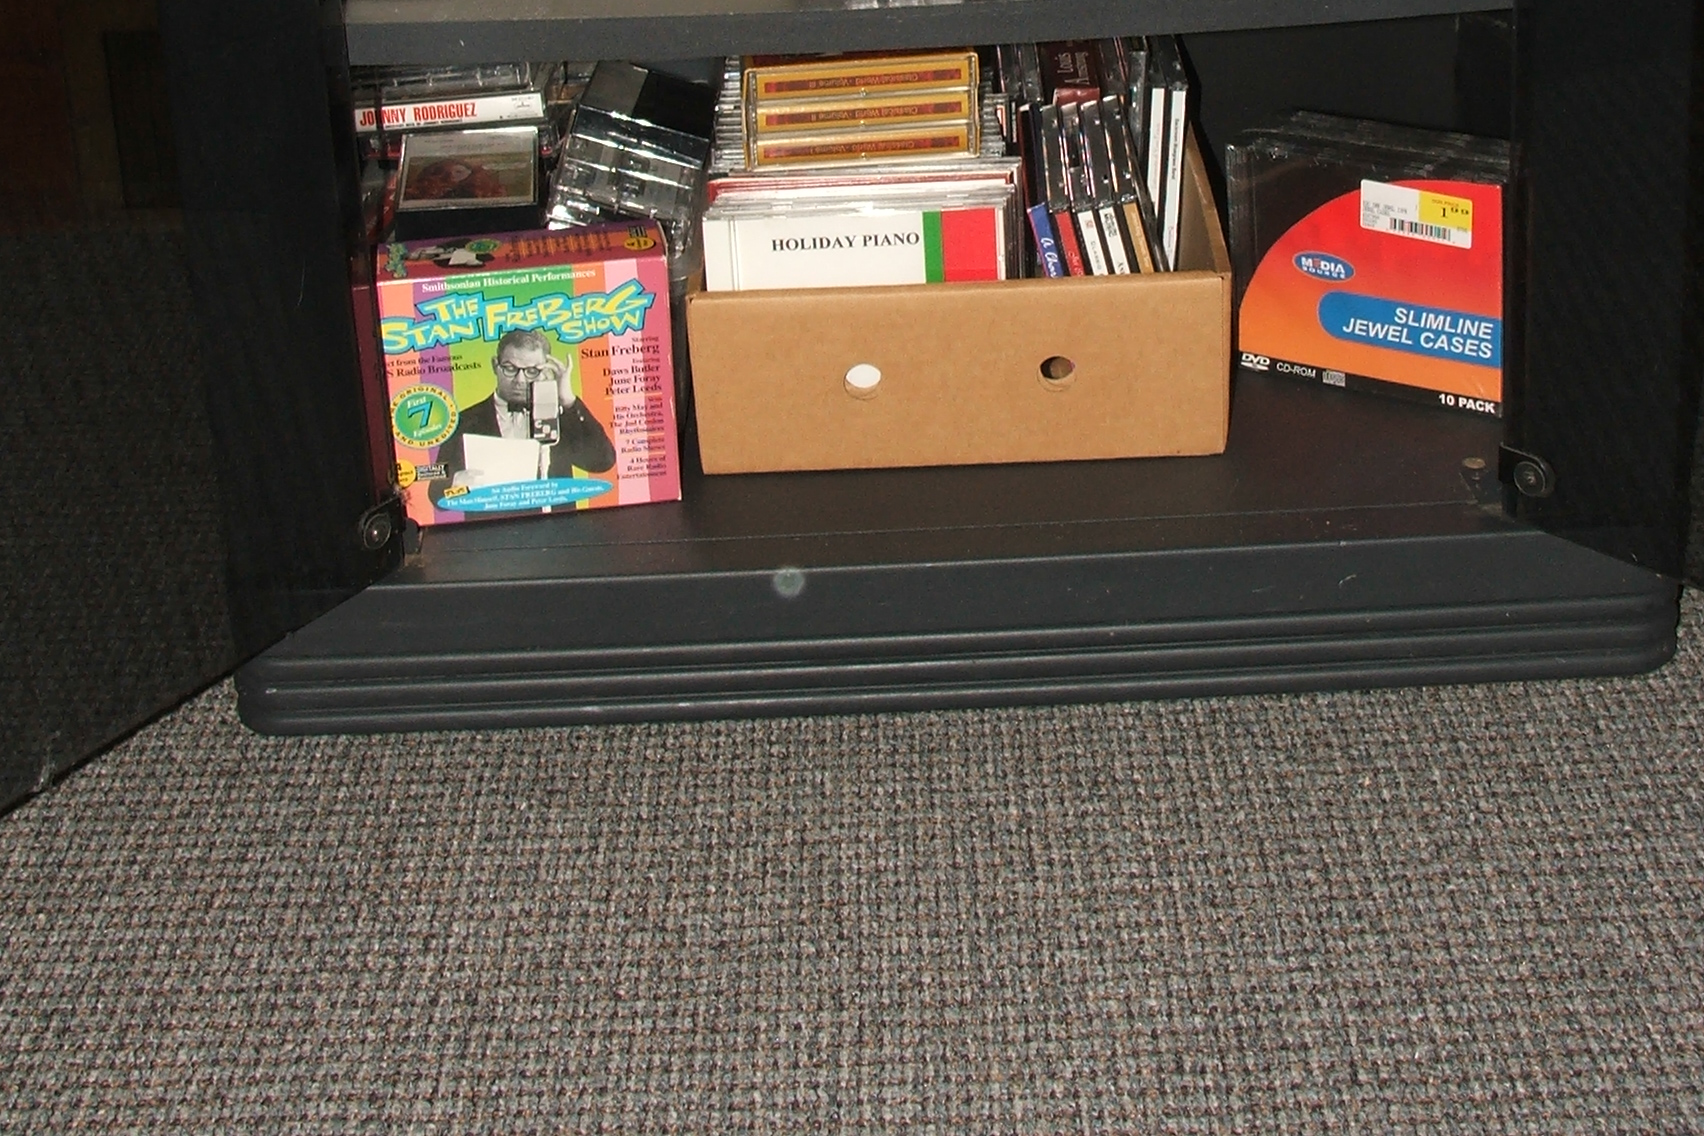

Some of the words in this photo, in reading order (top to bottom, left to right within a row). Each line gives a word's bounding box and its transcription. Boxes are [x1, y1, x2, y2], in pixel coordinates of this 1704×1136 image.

[818, 78, 848, 87] Volume
[854, 77, 879, 85] World
[880, 74, 919, 83] Classical
[360, 107, 406, 127] JONNY
[413, 102, 477, 123] RODRIGUEZ
[818, 111, 848, 119] Volume
[854, 109, 879, 118] World
[880, 107, 919, 116] Classical
[814, 145, 845, 154] Volume
[851, 144, 873, 152] World
[771, 235, 856, 252] HOLIDAY
[862, 232, 920, 249] PIANO
[1301, 256, 1345, 274] MEDIA
[422, 278, 481, 294] Smithsonian
[482, 273, 530, 288] Historical
[531, 268, 597, 284] Performances
[424, 297, 479, 323] THE
[381, 320, 475, 352] STAN
[485, 284, 649, 337] FREBERG
[560, 310, 641, 340] SHOW
[1394, 307, 1493, 340] SLIMLINE
[1342, 317, 1413, 346] JEWEL
[1420, 332, 1493, 359] CASES
[580, 348, 609, 359] Stan
[612, 344, 660, 356] Freberg
[396, 358, 416, 366] from
[432, 355, 463, 364] Famous
[1241, 353, 1271, 366] DVD
[396, 366, 426, 378] Radio
[428, 361, 482, 374] Broadcasts
[1276, 362, 1317, 379] CD-ROM
[400, 386, 448, 401] ORIGINAL
[605, 385, 630, 396] Peter
[407, 396, 426, 409] First
[1438, 393, 1455, 407] 10
[1458, 397, 1497, 415] PACK
[407, 400, 433, 429] 7
